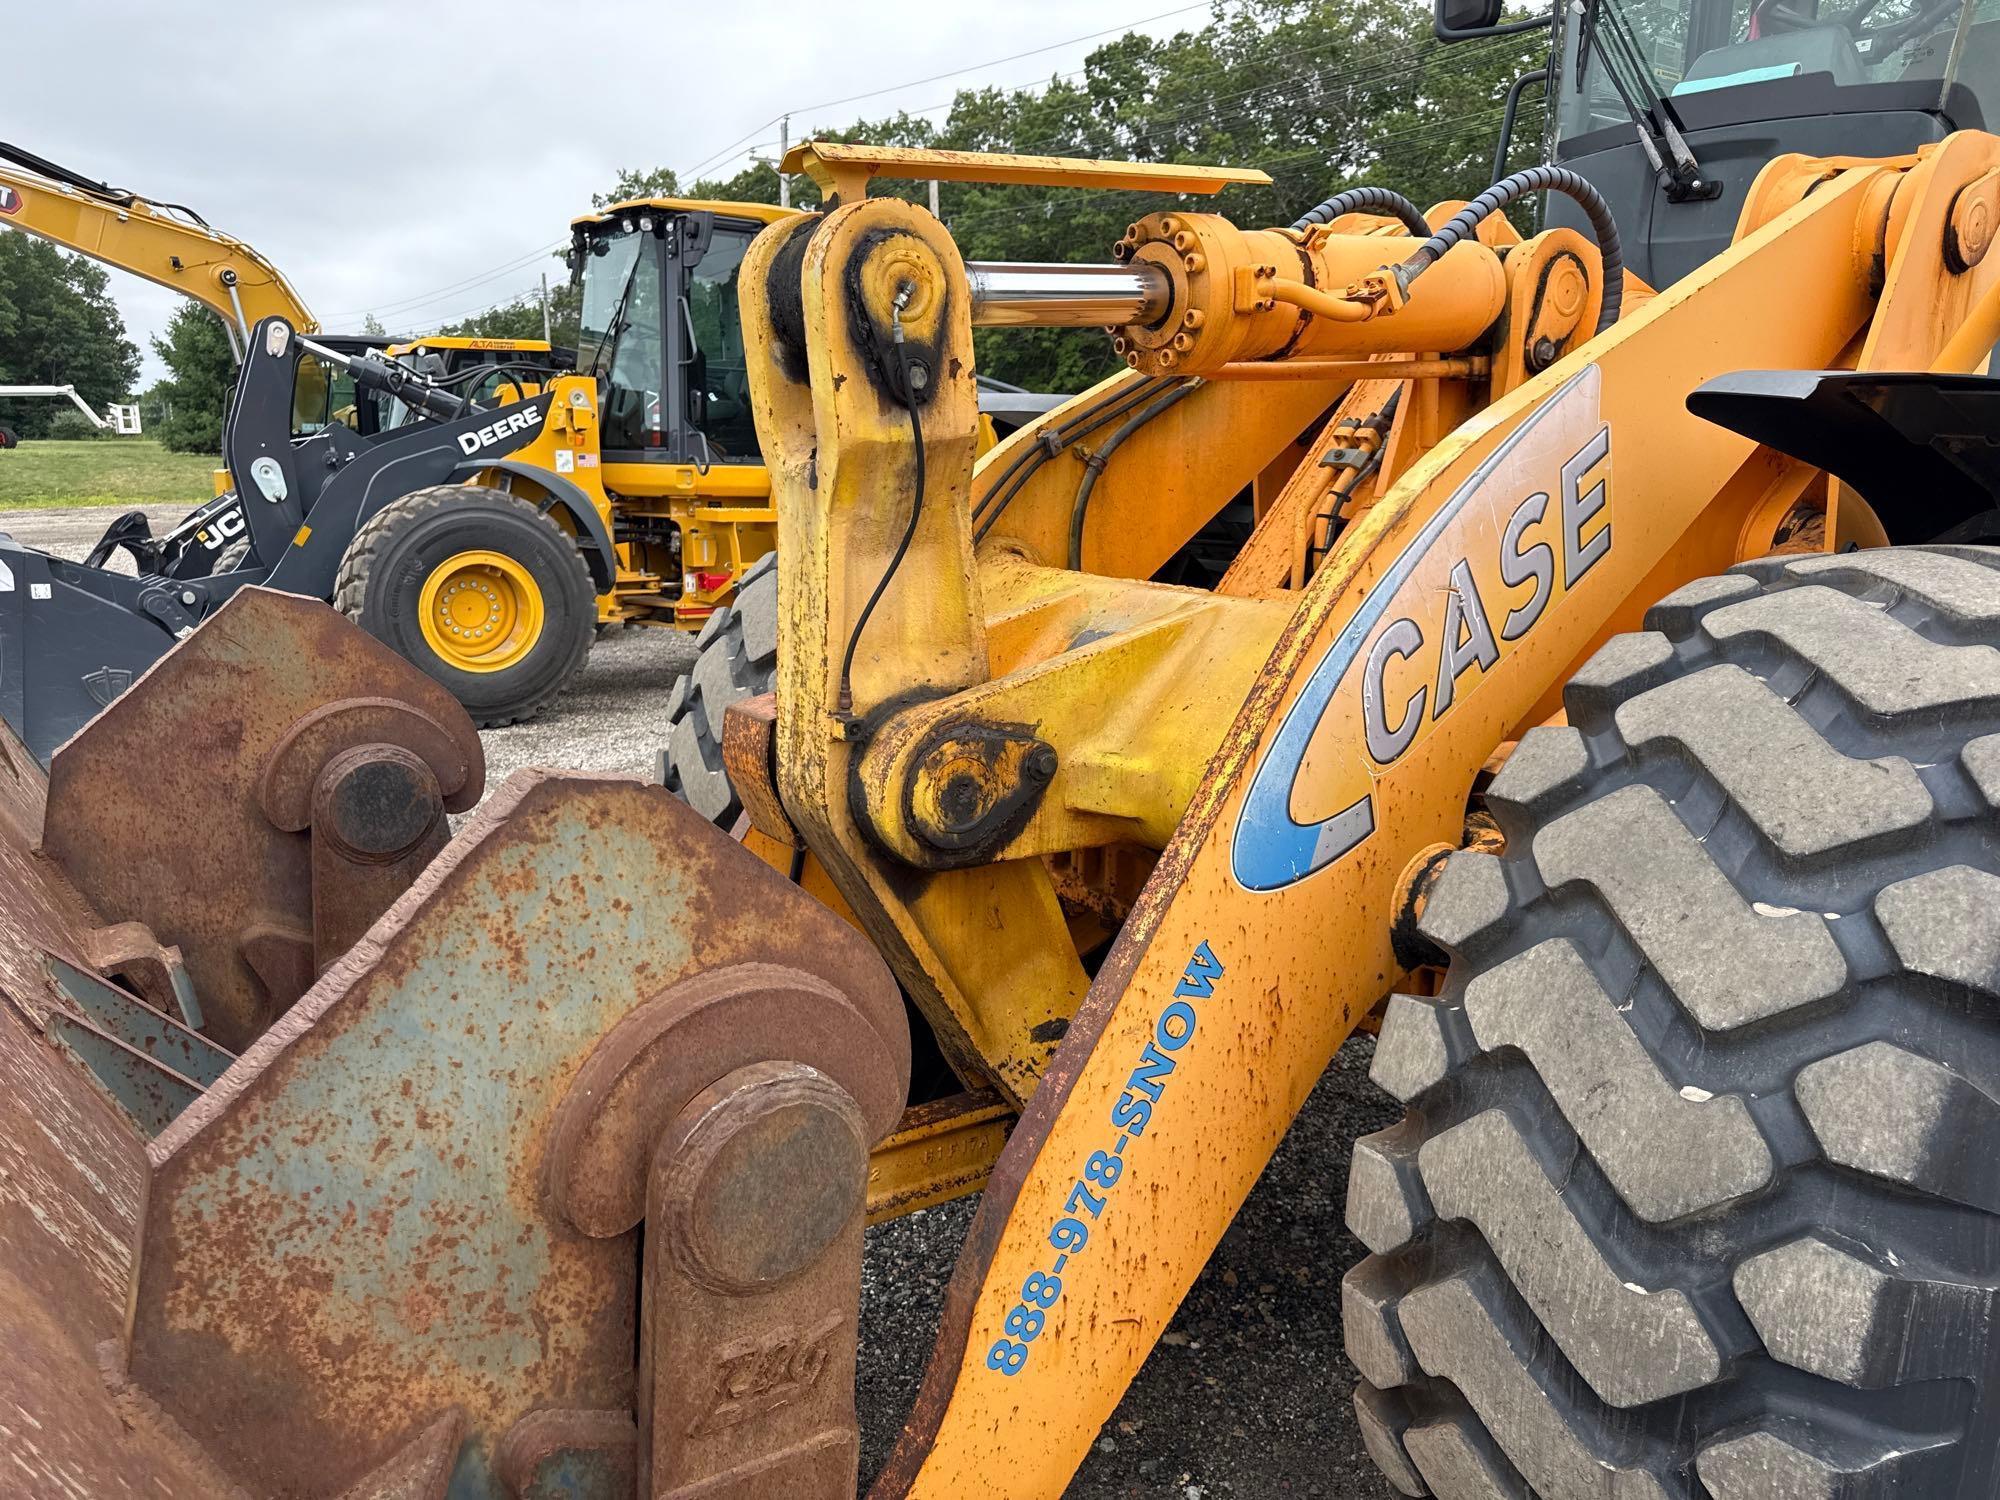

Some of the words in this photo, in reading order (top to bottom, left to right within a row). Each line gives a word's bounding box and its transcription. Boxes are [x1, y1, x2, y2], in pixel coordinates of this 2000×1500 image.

[469, 340, 493, 349] ALTA
[457, 405, 543, 456] DEERE
[203, 505, 246, 550] JC
[1361, 425, 1612, 765] CASE
[986, 938, 1227, 1378] 888-978-SNOW
